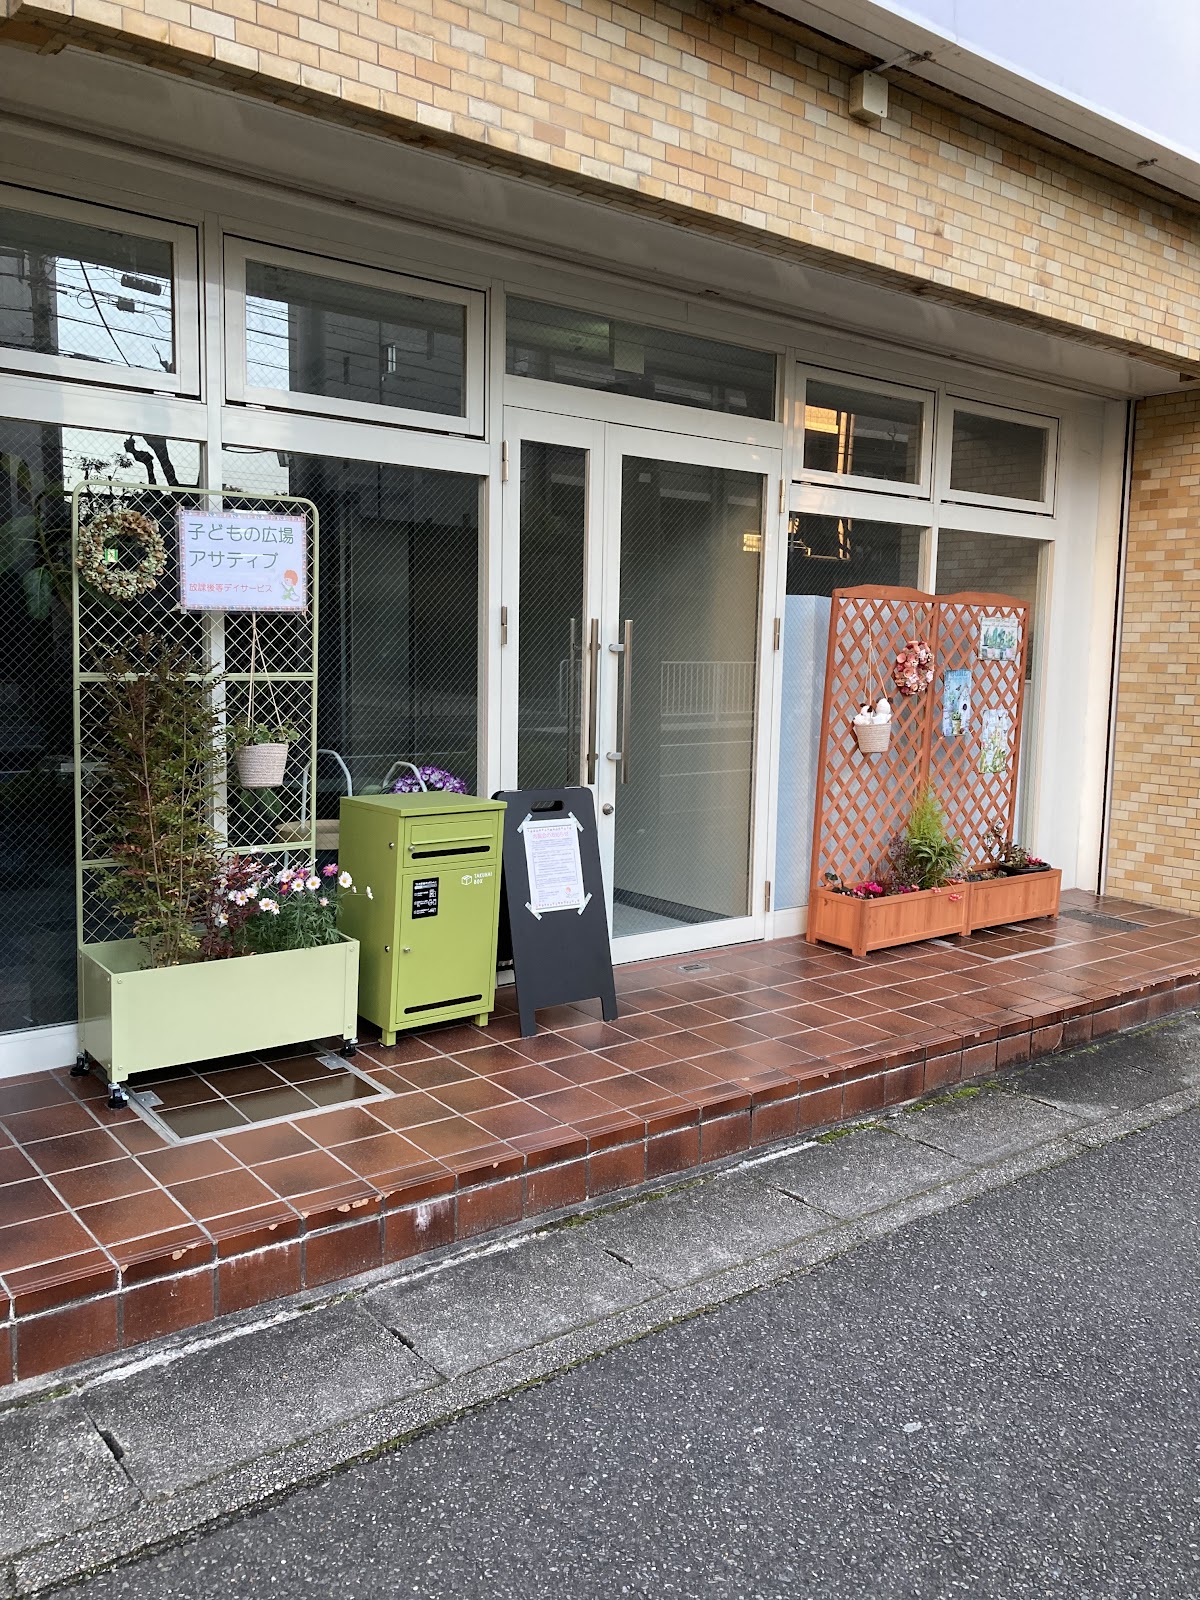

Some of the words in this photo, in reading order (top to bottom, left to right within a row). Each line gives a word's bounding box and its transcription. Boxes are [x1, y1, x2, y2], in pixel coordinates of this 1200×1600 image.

[188, 523, 294, 544] 子どもの広場
[189, 582, 273, 593] 放課後等デイサービス
